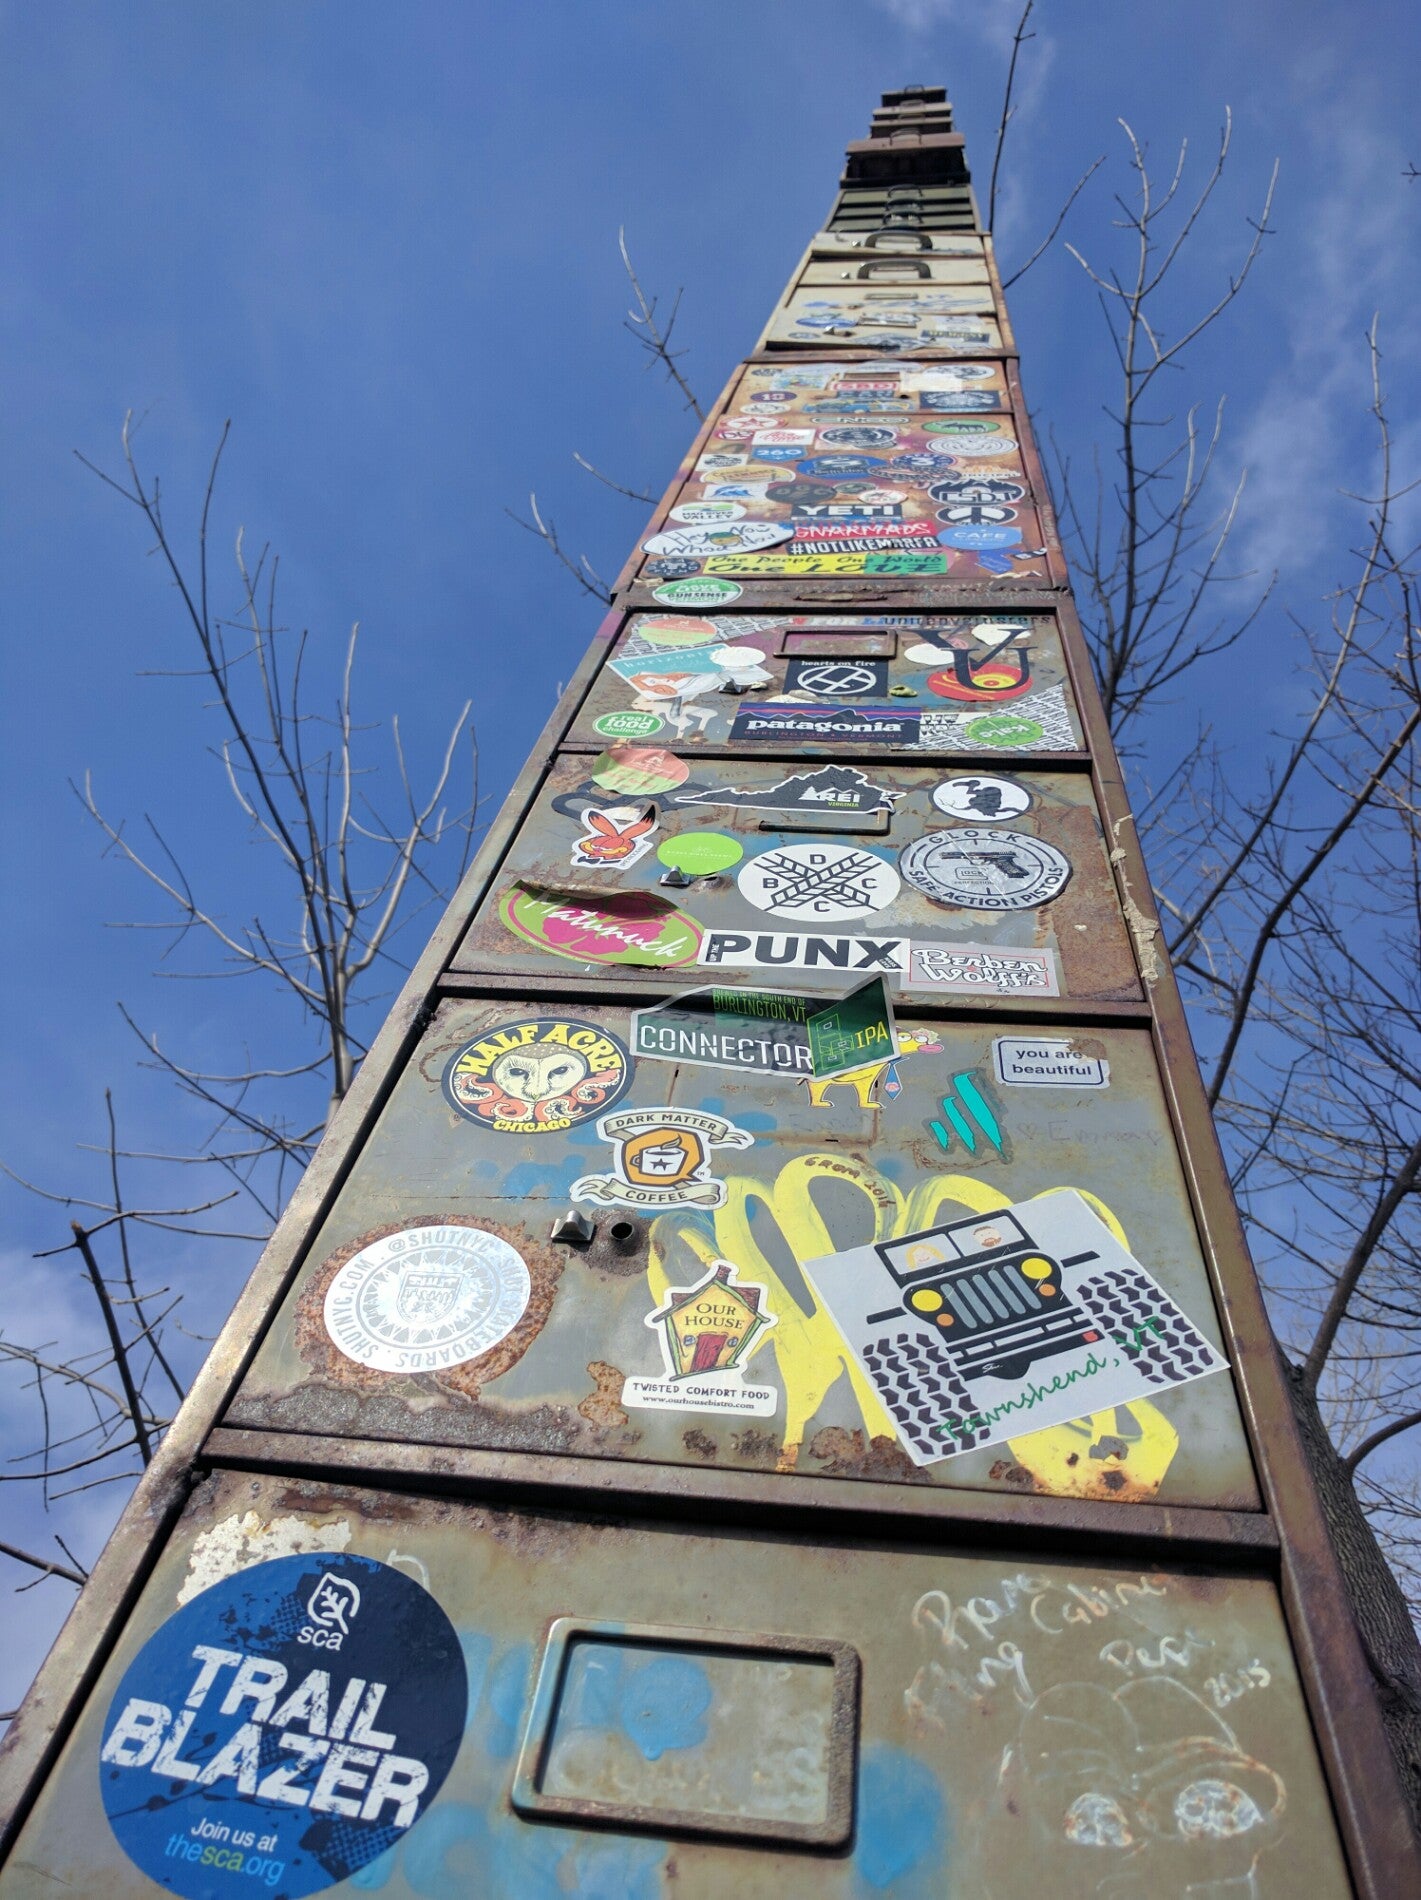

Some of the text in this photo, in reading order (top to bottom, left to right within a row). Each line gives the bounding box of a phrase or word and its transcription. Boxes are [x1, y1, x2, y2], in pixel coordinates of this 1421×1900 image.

[799, 505, 894, 516] YETI
[953, 531, 1007, 539] CAFE
[711, 555, 748, 563] One
[758, 556, 822, 564] People
[708, 563, 942, 573] One LOVE
[605, 716, 654, 730] food
[746, 719, 902, 733] patagonia
[602, 727, 650, 736] challenge
[821, 792, 861, 804] REI
[929, 830, 1021, 844] GLOCK
[810, 854, 827, 866] D
[762, 877, 779, 889] B
[860, 877, 878, 890] C
[908, 867, 1064, 907] SAFE ACTION PISTOLS
[814, 900, 831, 912] C
[705, 934, 904, 970] PUNX
[712, 994, 807, 1024] BURLINGTON, VT
[855, 1020, 889, 1051] IPA
[456, 1024, 623, 1075] HALF ACRE
[640, 1023, 813, 1071] CONNECTOR
[1015, 1050, 1082, 1059] you are
[1011, 1063, 1092, 1076] beautiful
[493, 1116, 573, 1134] CHICAGO
[616, 1113, 718, 1132] DARK MATTER
[625, 1188, 690, 1204] COFFEE
[387, 1229, 495, 1253] @SHUTNYC
[499, 1256, 526, 1294] SHUT
[332, 1258, 380, 1360] SHUTNYC.COM
[695, 1302, 737, 1316] OUR
[684, 1315, 745, 1330] HOUSE
[395, 1299, 522, 1369] SKATEBOARDS
[1113, 1314, 1167, 1354] VT
[686, 1386, 738, 1398] COMFORT
[741, 1389, 770, 1400] FOOD
[642, 1395, 755, 1410] www.ourhousebistro.com
[296, 1624, 344, 1651] sca
[184, 1644, 397, 1751] TRAIL
[101, 1698, 430, 1829] BLAZER
[190, 1816, 279, 1853] Join us at
[164, 1833, 286, 1888] thesca.org
